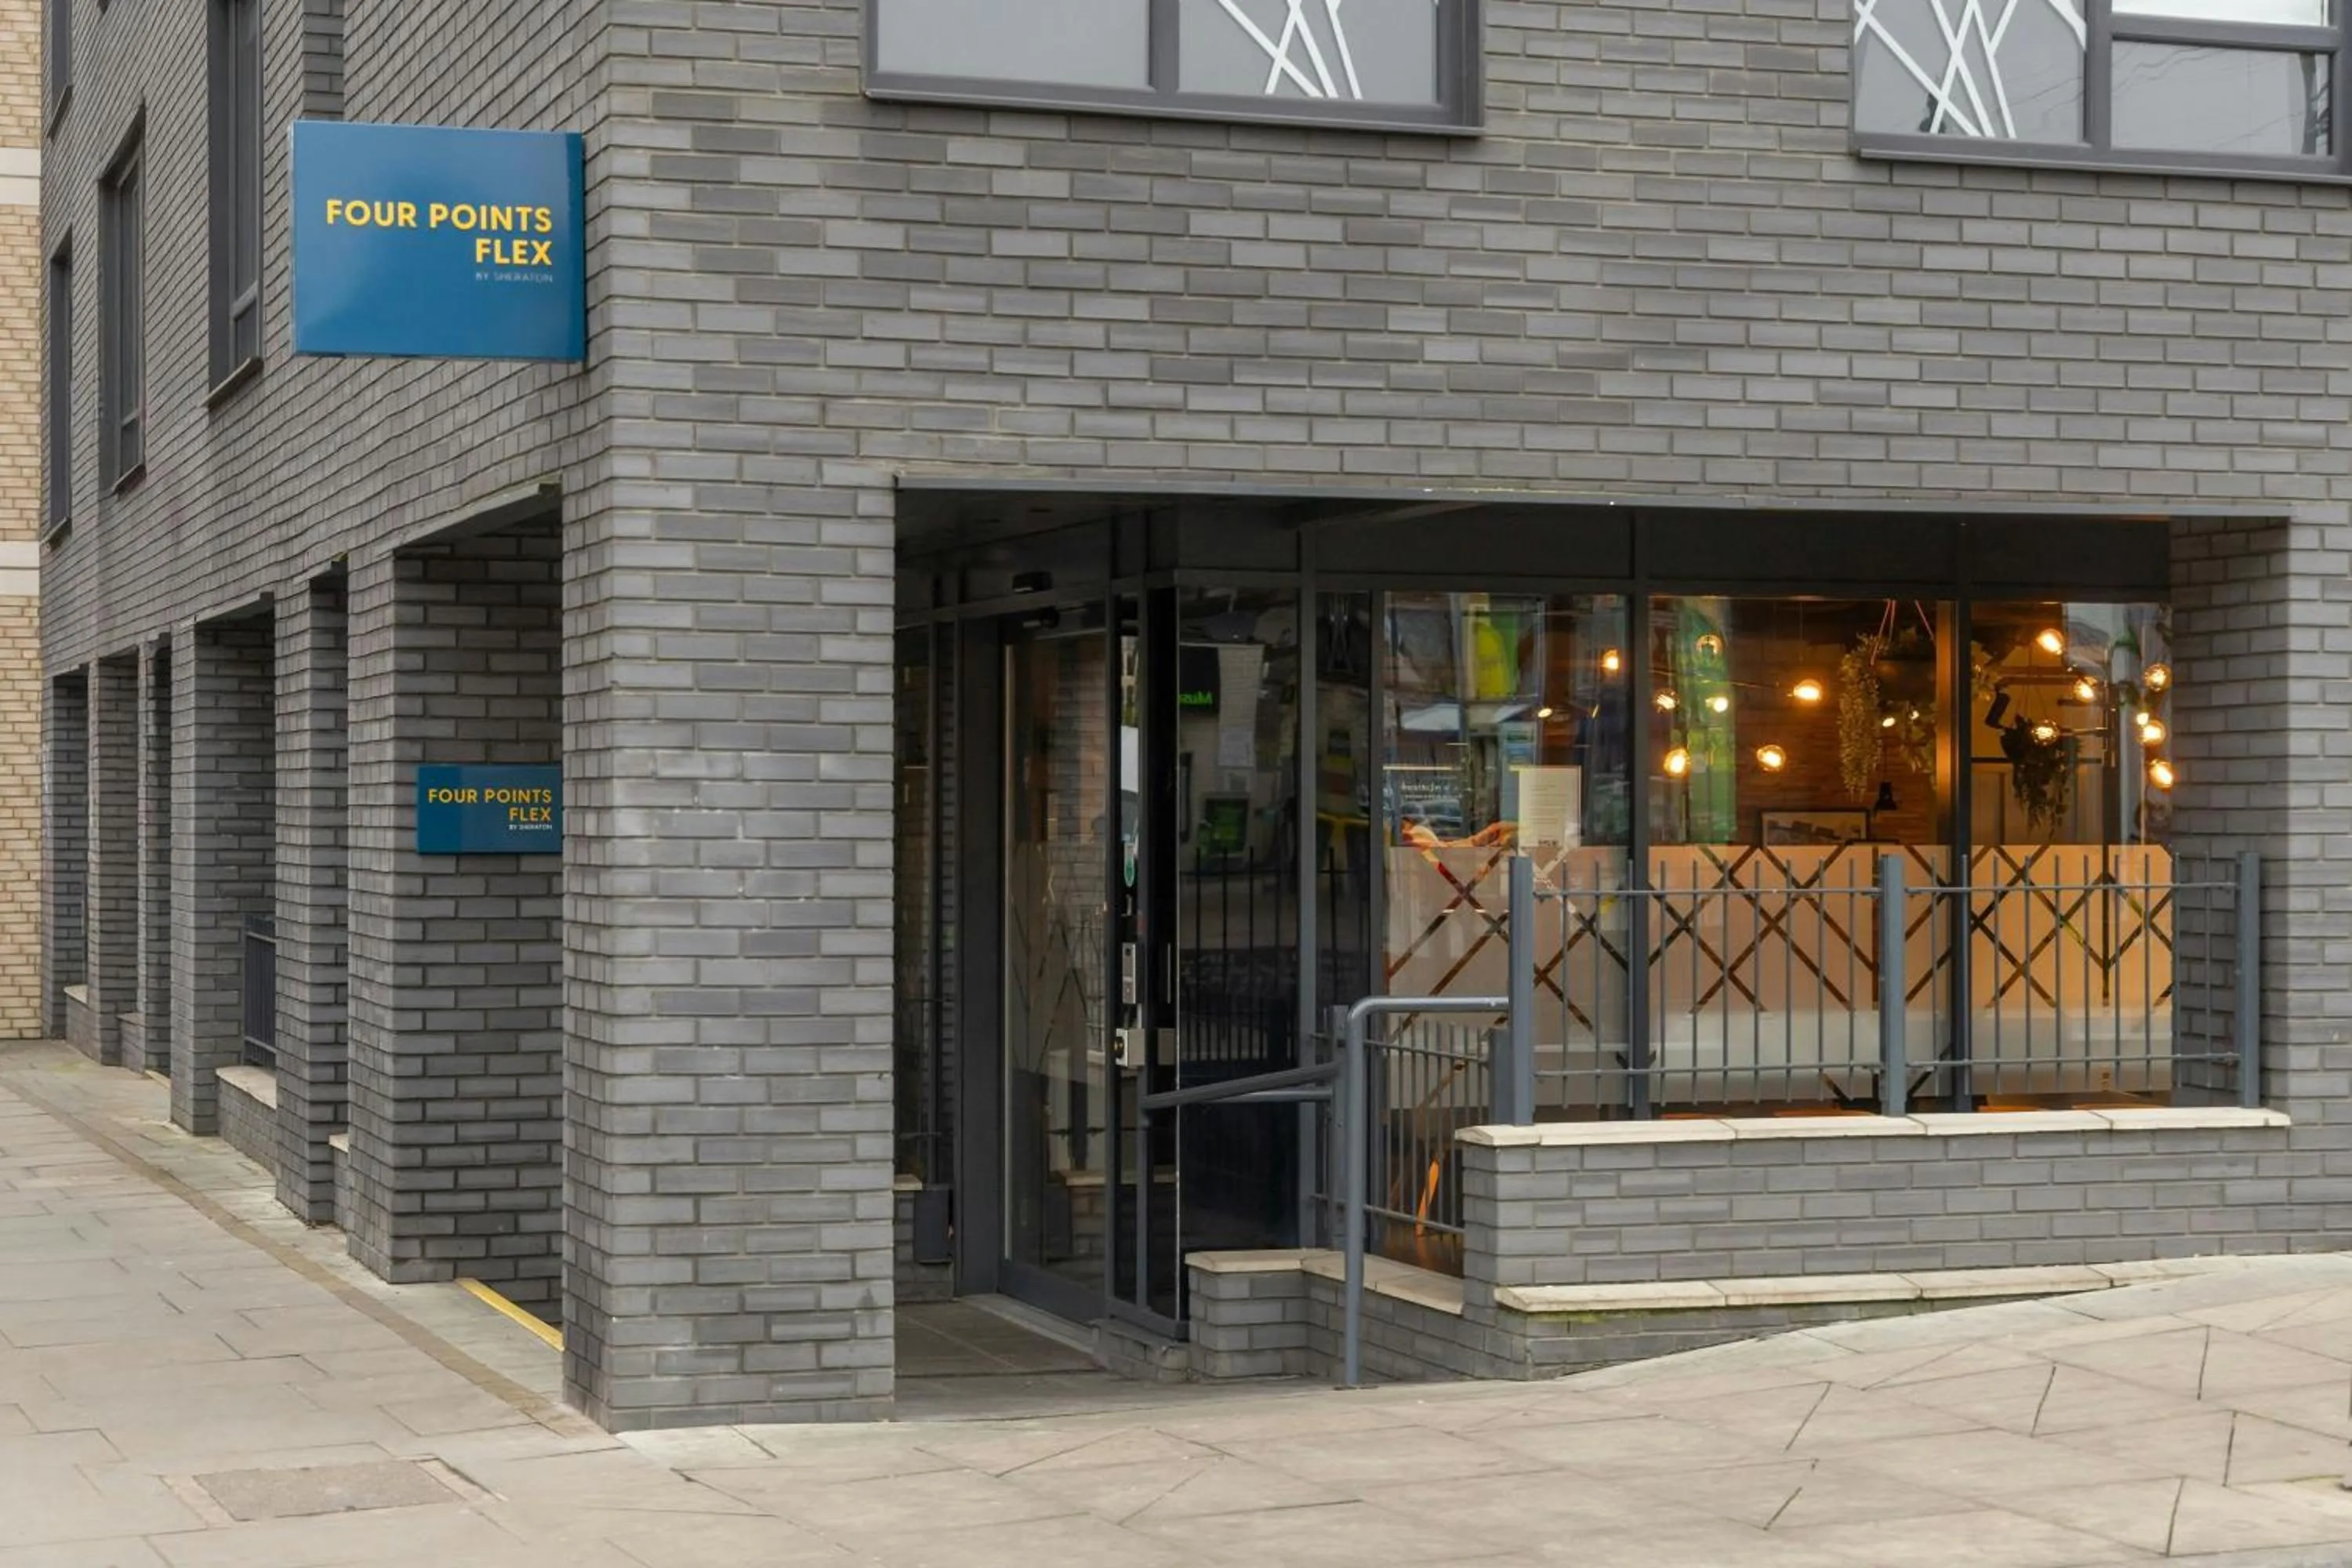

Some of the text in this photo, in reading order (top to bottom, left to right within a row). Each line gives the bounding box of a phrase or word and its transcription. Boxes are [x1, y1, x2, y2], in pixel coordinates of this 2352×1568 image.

[326, 199, 553, 234] FOUR POINTS
[475, 238, 553, 266] FLEX
[475, 272, 554, 283] BY SHERATON
[428, 789, 552, 804] FOUR POINTS
[509, 807, 551, 822] FLEX
